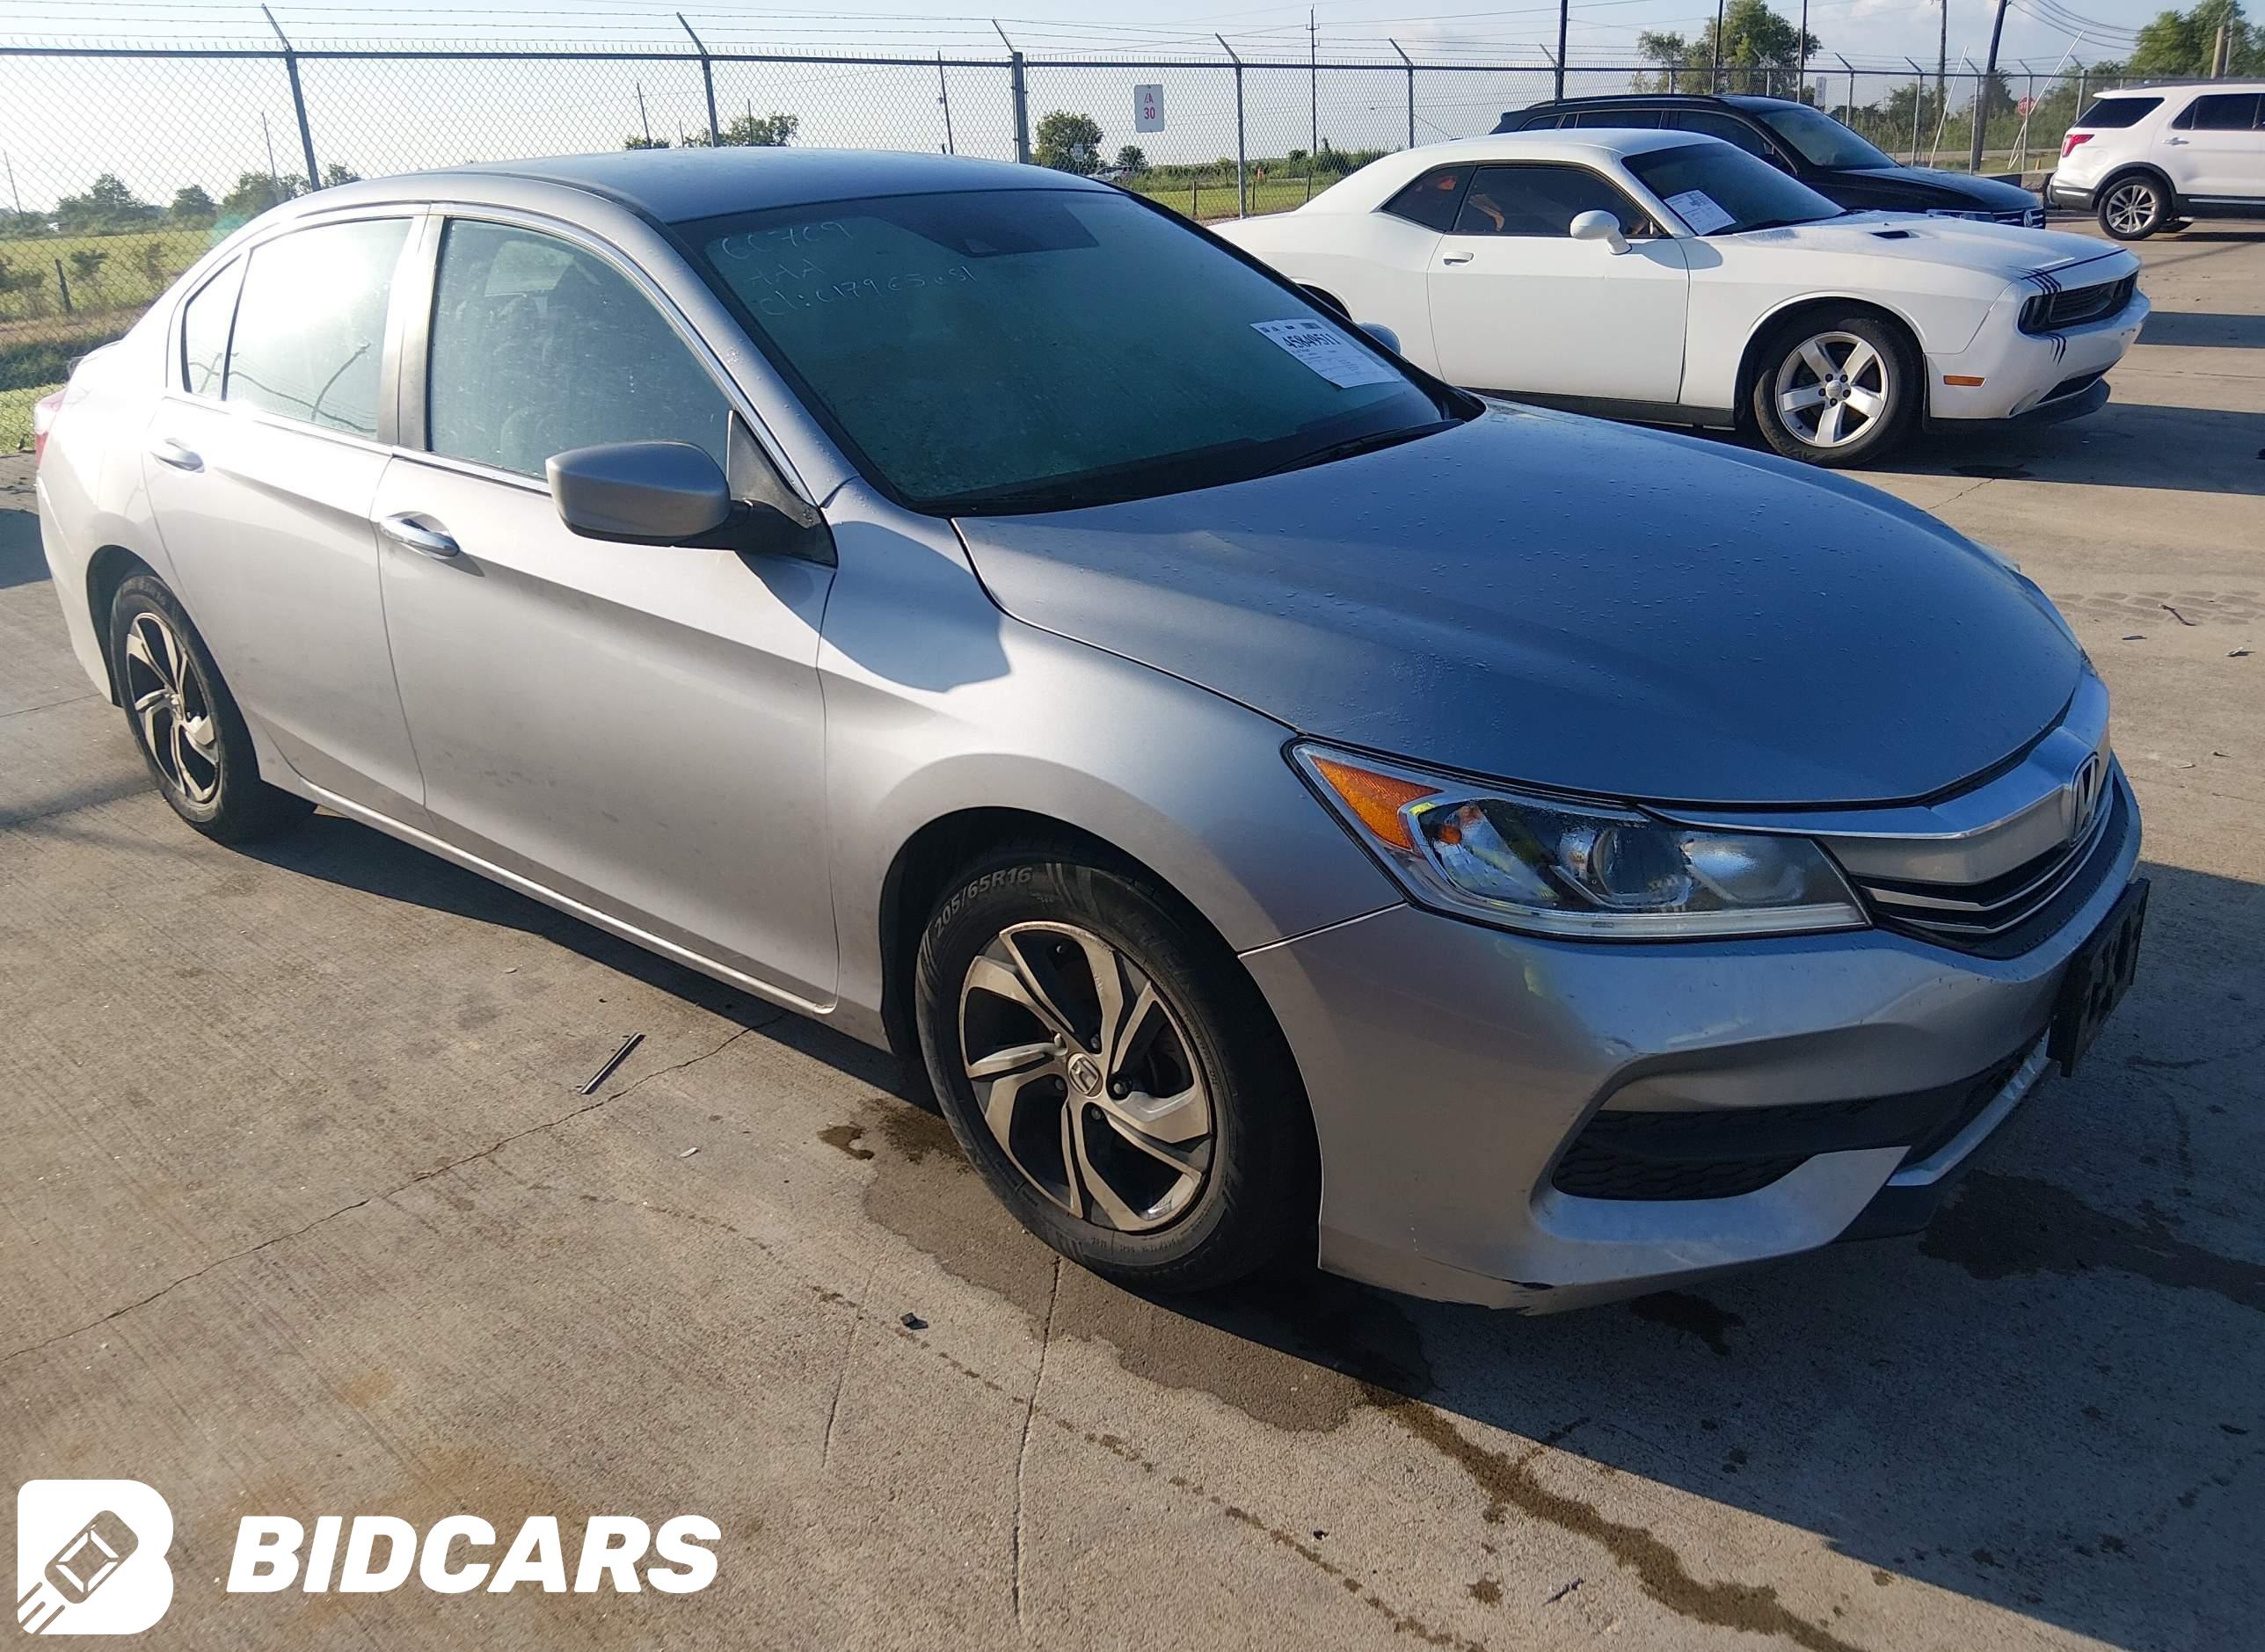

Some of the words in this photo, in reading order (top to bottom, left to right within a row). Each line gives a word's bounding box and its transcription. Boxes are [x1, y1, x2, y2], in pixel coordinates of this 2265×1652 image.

[1144, 106, 1155, 120] 30
[1281, 333, 1342, 349] 45849511
[933, 866, 1033, 939] 205/65R16
